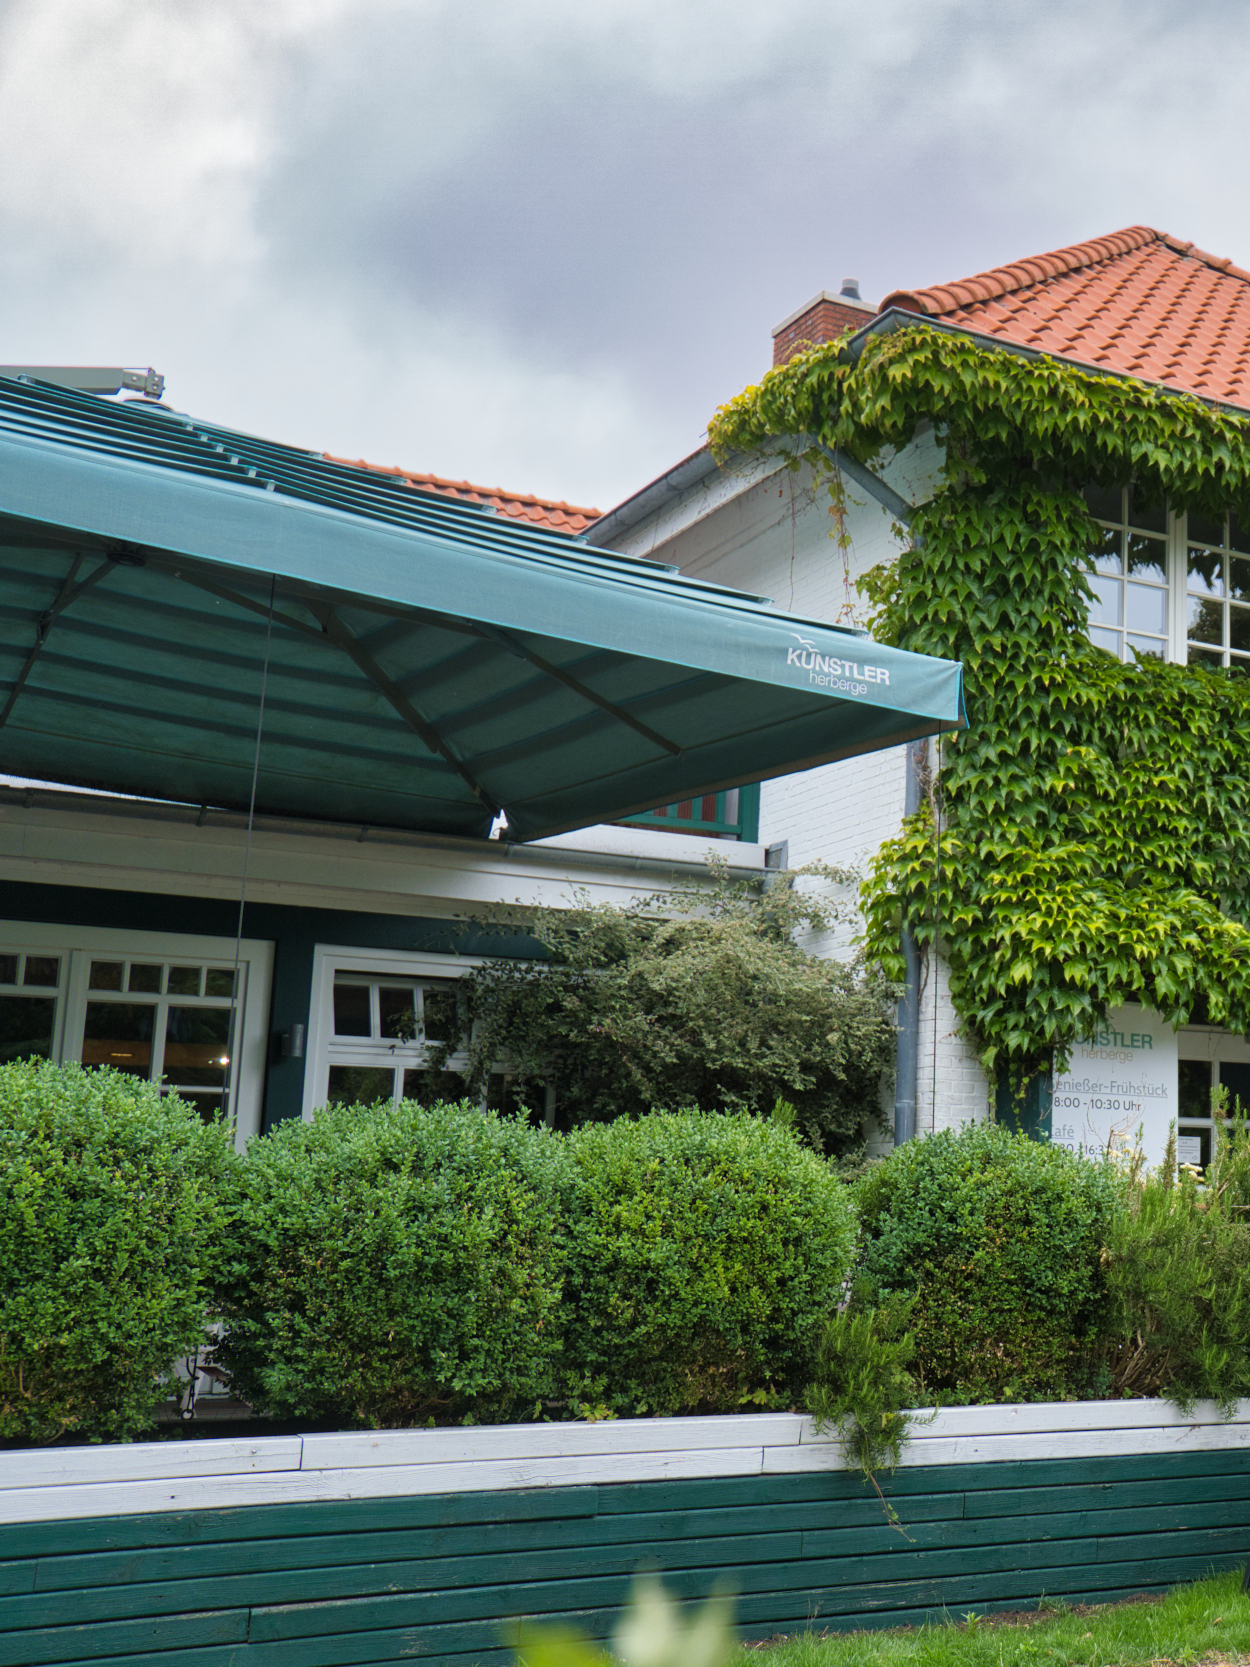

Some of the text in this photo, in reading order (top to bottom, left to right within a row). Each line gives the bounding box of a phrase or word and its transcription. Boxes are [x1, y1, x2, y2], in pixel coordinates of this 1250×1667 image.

[809, 670, 868, 696] herberge
[1081, 1046, 1134, 1063] herberge
[1054, 1078, 1168, 1096] enießer-Frühstück
[1090, 1099, 1120, 1110] 10:30
[1123, 1100, 1141, 1111] Uhr
